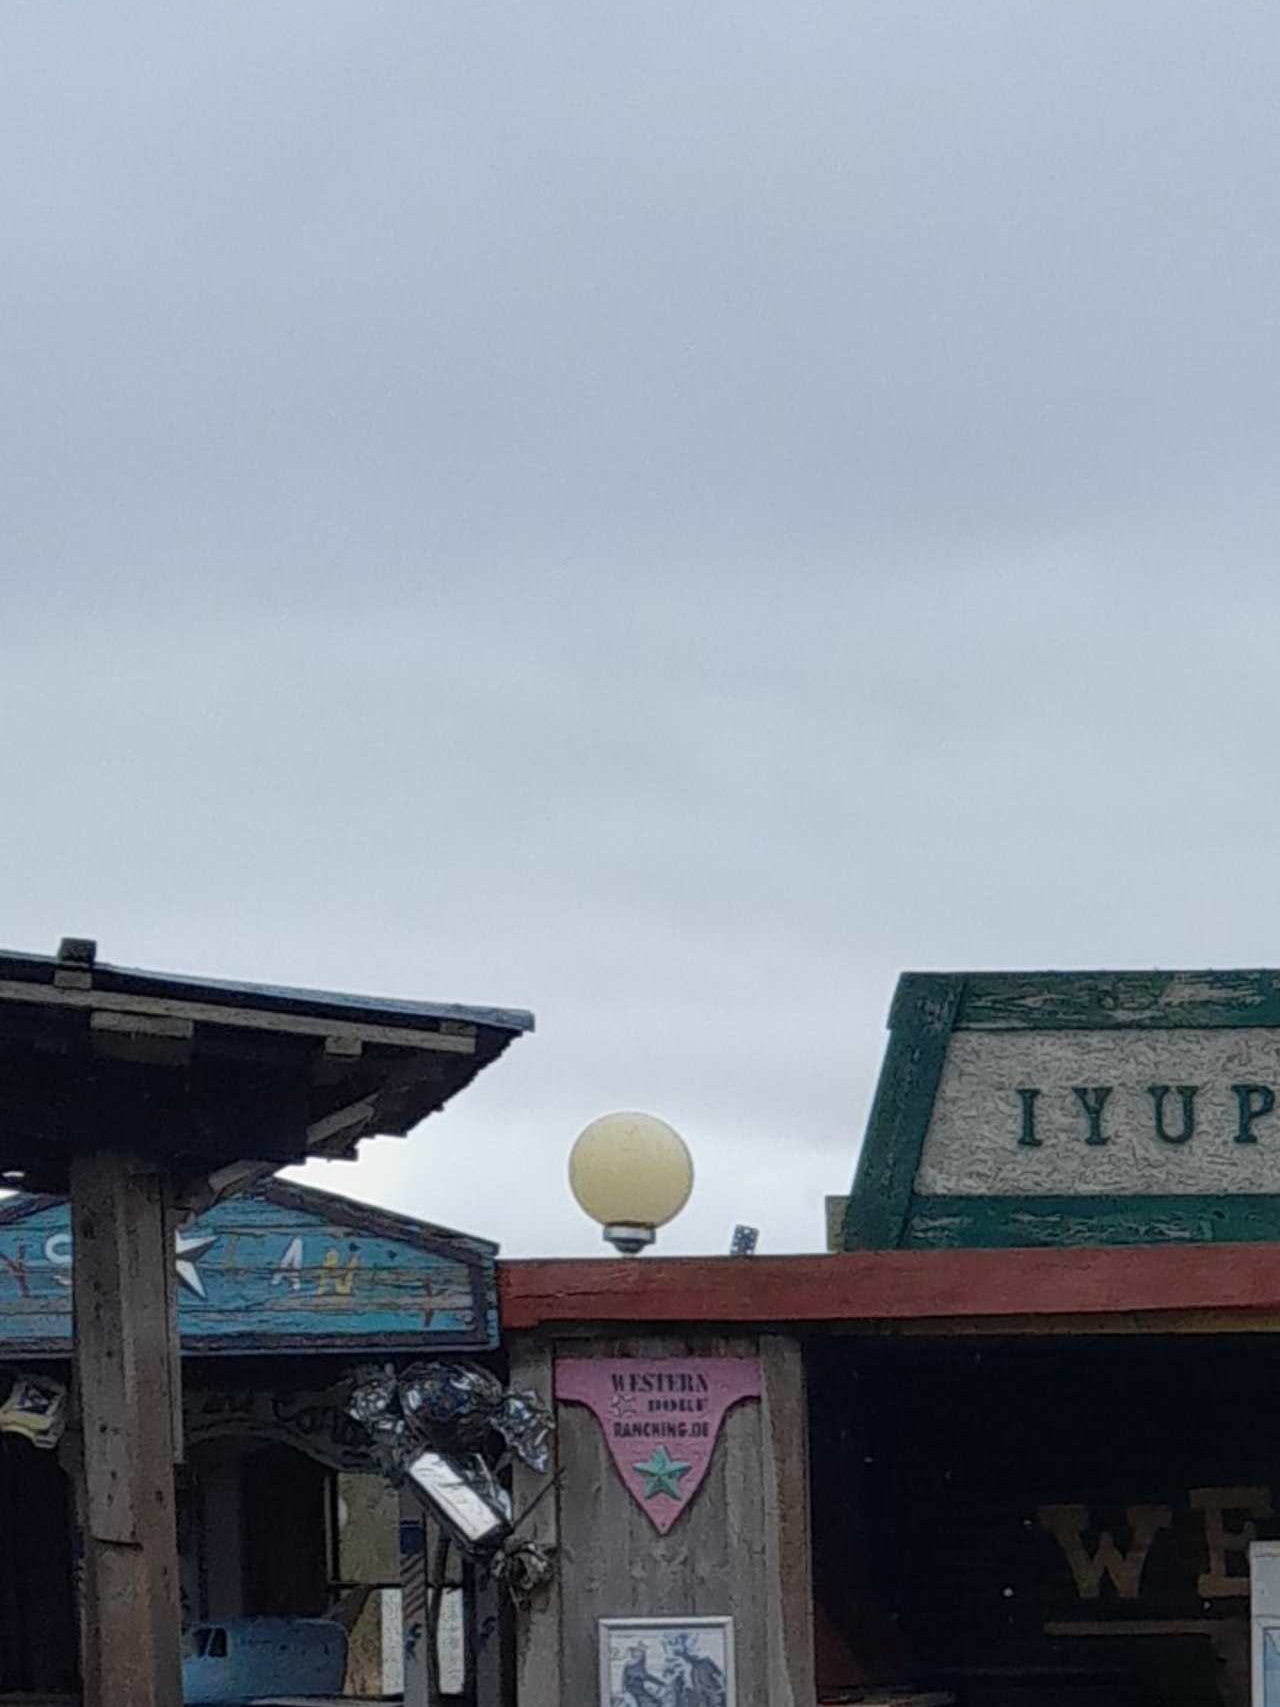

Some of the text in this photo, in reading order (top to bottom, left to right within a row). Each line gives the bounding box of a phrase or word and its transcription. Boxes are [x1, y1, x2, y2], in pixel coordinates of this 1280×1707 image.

[610, 1372, 710, 1393] WESTERN
[647, 1397, 707, 1413] DORF
[613, 1421, 710, 1438] RANCHING.DE
